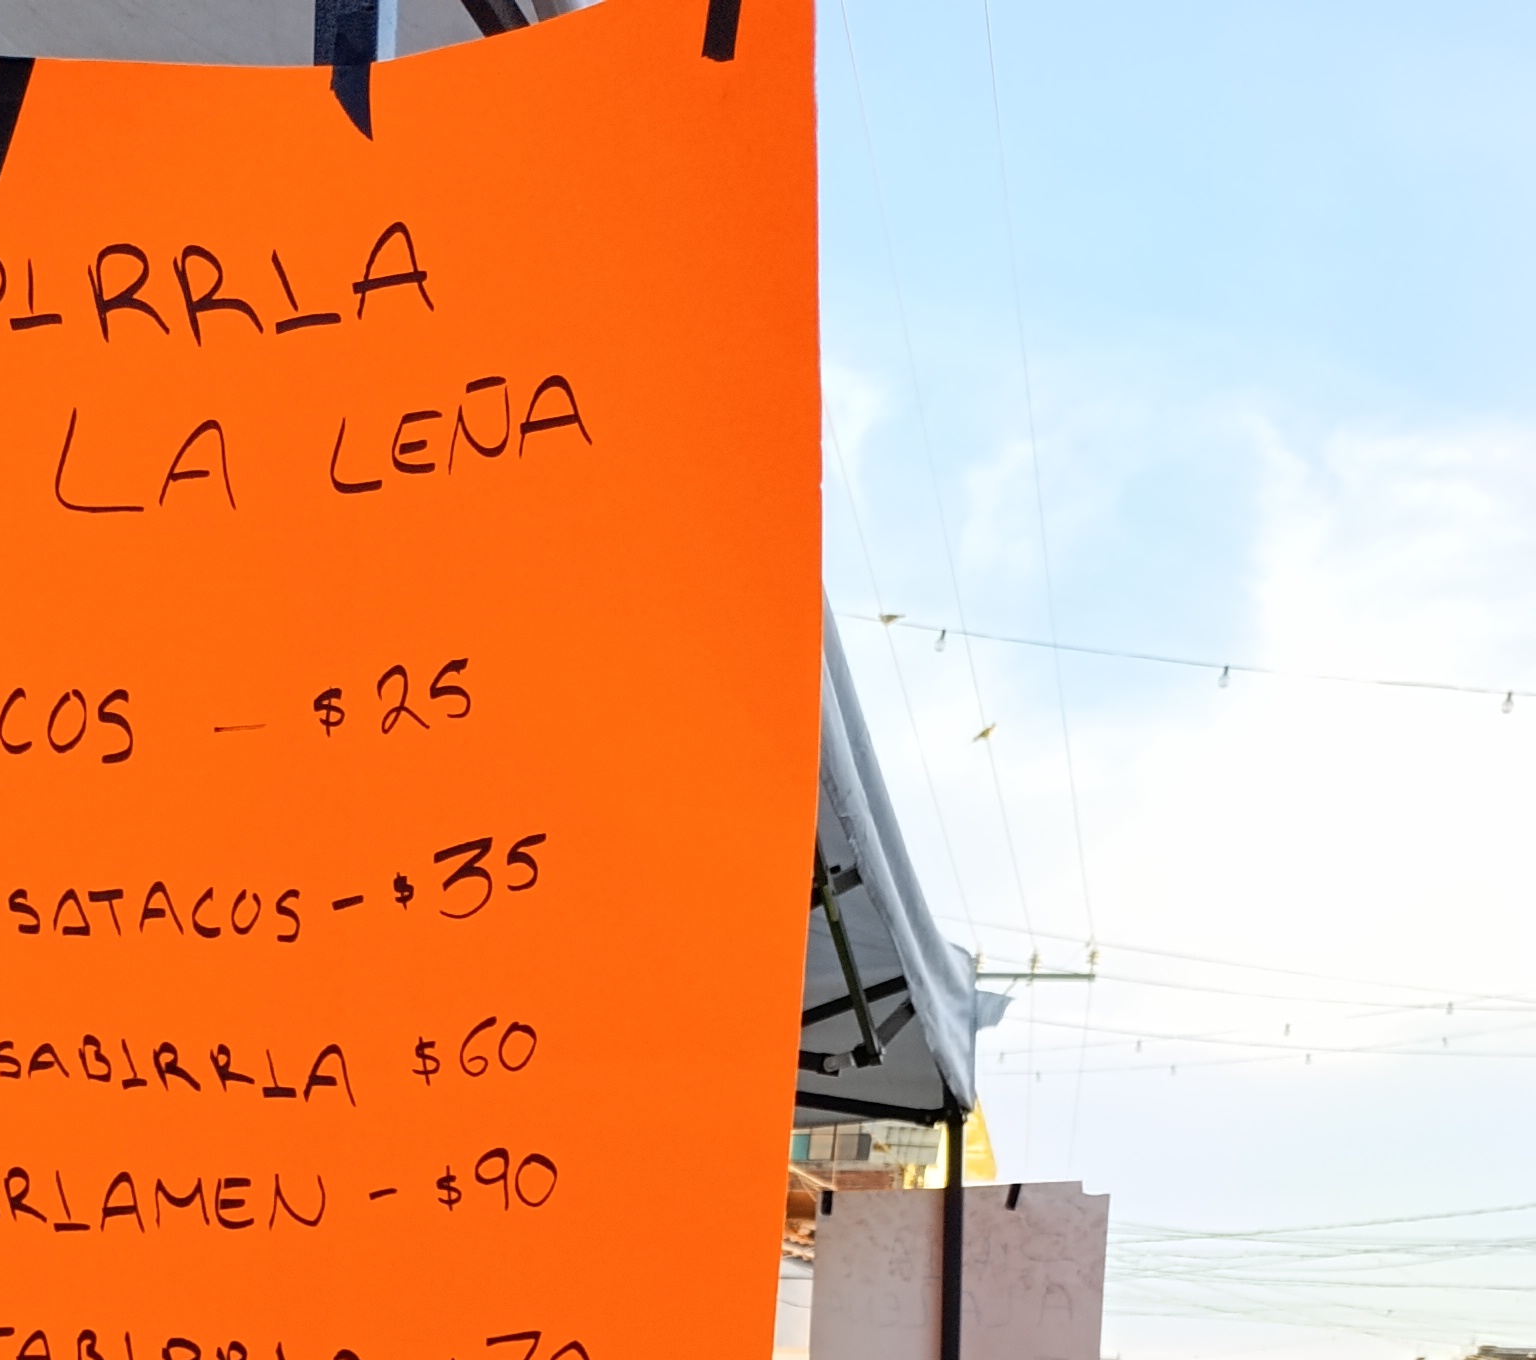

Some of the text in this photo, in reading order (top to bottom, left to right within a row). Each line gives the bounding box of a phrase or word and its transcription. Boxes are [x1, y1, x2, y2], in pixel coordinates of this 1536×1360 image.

[55, 409, 235, 513] LA
[330, 375, 592, 494] LEÑA
[314, 658, 470, 736] $25
[394, 833, 546, 919] $35
[413, 1017, 536, 1085] $60
[436, 1148, 557, 1210] $90
